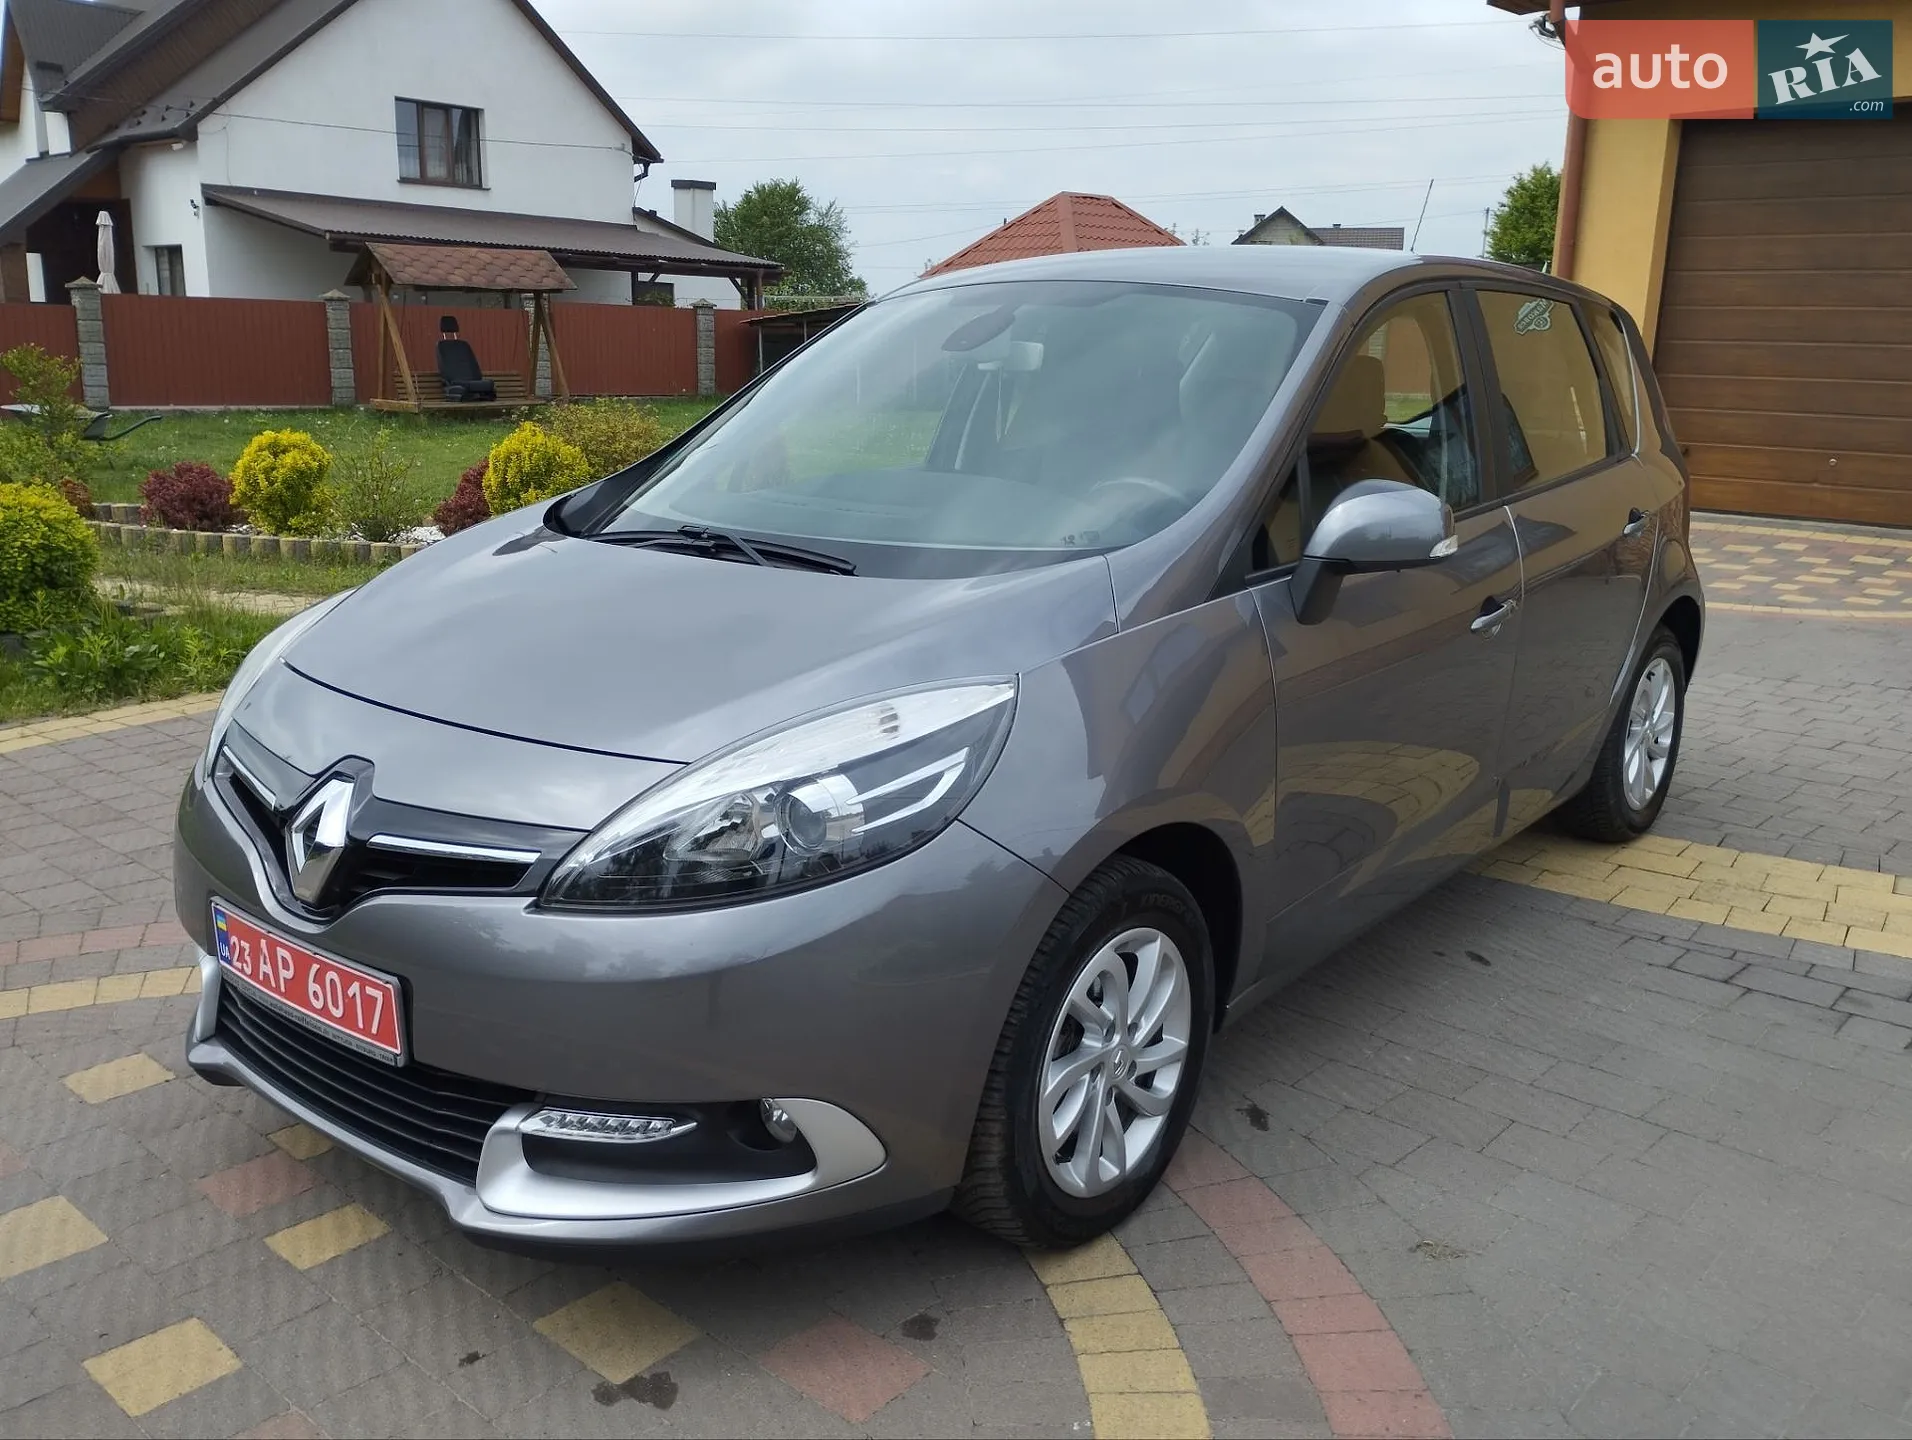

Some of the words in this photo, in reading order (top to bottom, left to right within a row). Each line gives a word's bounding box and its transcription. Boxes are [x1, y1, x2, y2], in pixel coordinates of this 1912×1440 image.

[219, 942, 230, 961] UA
[230, 936, 251, 976] 23
[259, 939, 294, 992] AP
[308, 964, 383, 1034] 6017
